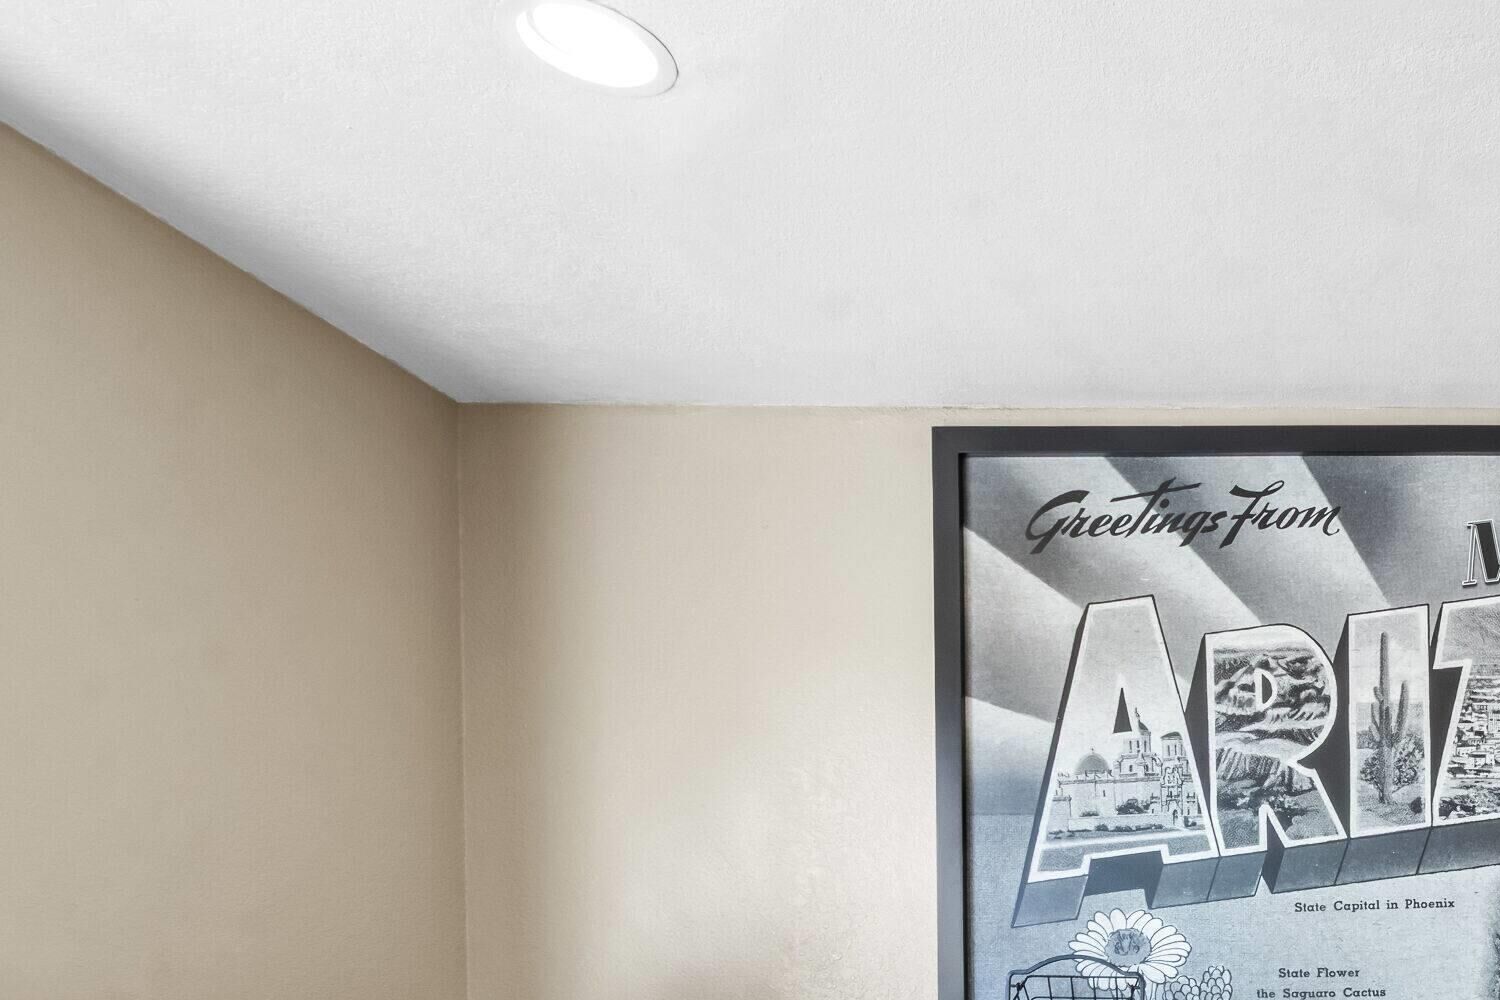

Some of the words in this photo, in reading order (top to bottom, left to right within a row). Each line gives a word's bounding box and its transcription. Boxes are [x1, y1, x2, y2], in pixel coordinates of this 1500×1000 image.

[1024, 477, 1221, 554] Greetings
[1218, 479, 1341, 549] From
[1294, 901, 1327, 913] State
[1333, 899, 1381, 913] Capital
[1386, 899, 1399, 911] in
[1404, 897, 1456, 910] Phoenix
[1278, 967, 1311, 979] State
[1316, 967, 1361, 979] Flower
[1256, 988, 1276, 999] the
[1282, 987, 1337, 1000] Saguaro
[1342, 987, 1387, 998] Cactus
